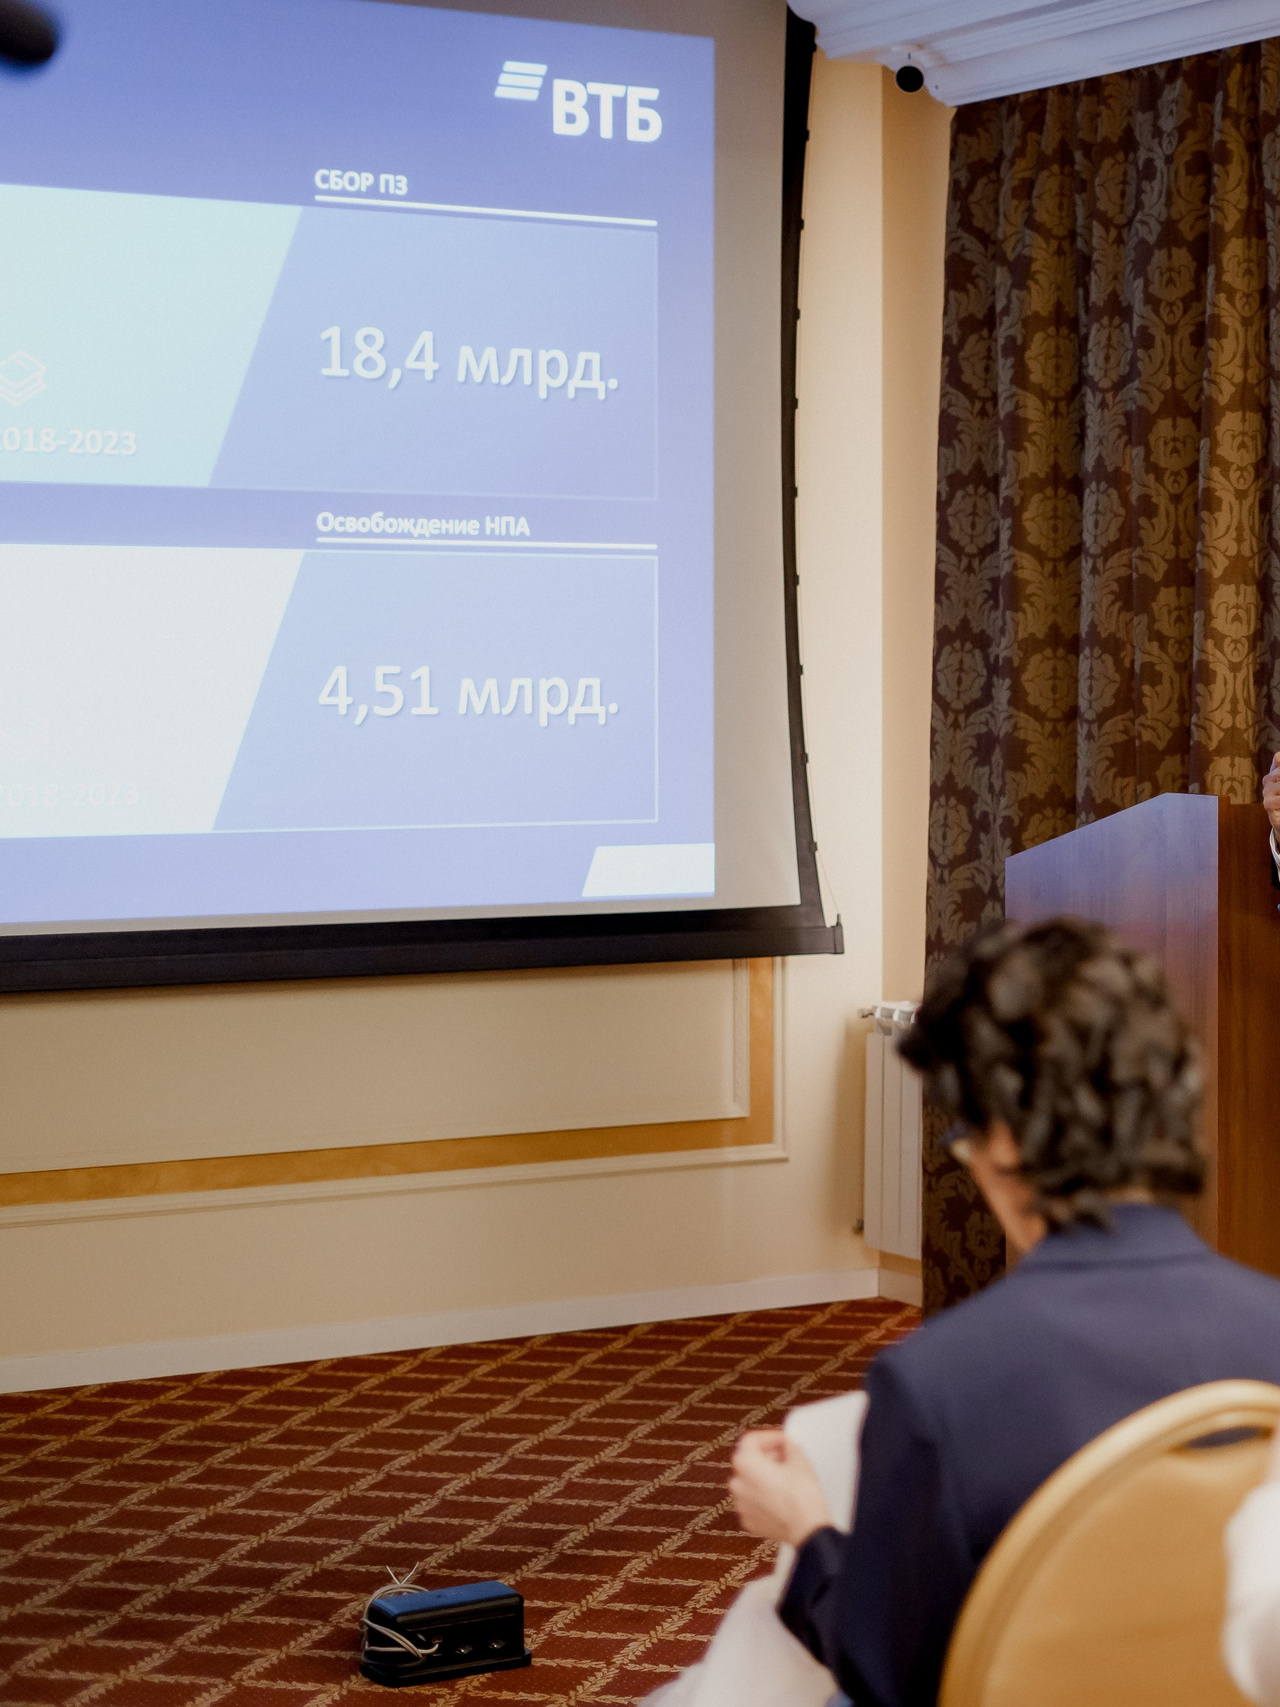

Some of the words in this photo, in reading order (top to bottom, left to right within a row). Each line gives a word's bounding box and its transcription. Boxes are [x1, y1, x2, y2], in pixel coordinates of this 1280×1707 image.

[553, 78, 662, 143] ВТБ
[314, 168, 374, 192] СБОР
[320, 325, 440, 389] 18,4
[457, 345, 619, 400] млрд.
[2, 426, 138, 455] 018-2023
[316, 511, 480, 538] Освобождение
[485, 515, 531, 537] НПА
[318, 665, 440, 726] 4,51
[458, 677, 619, 728] млрд.
